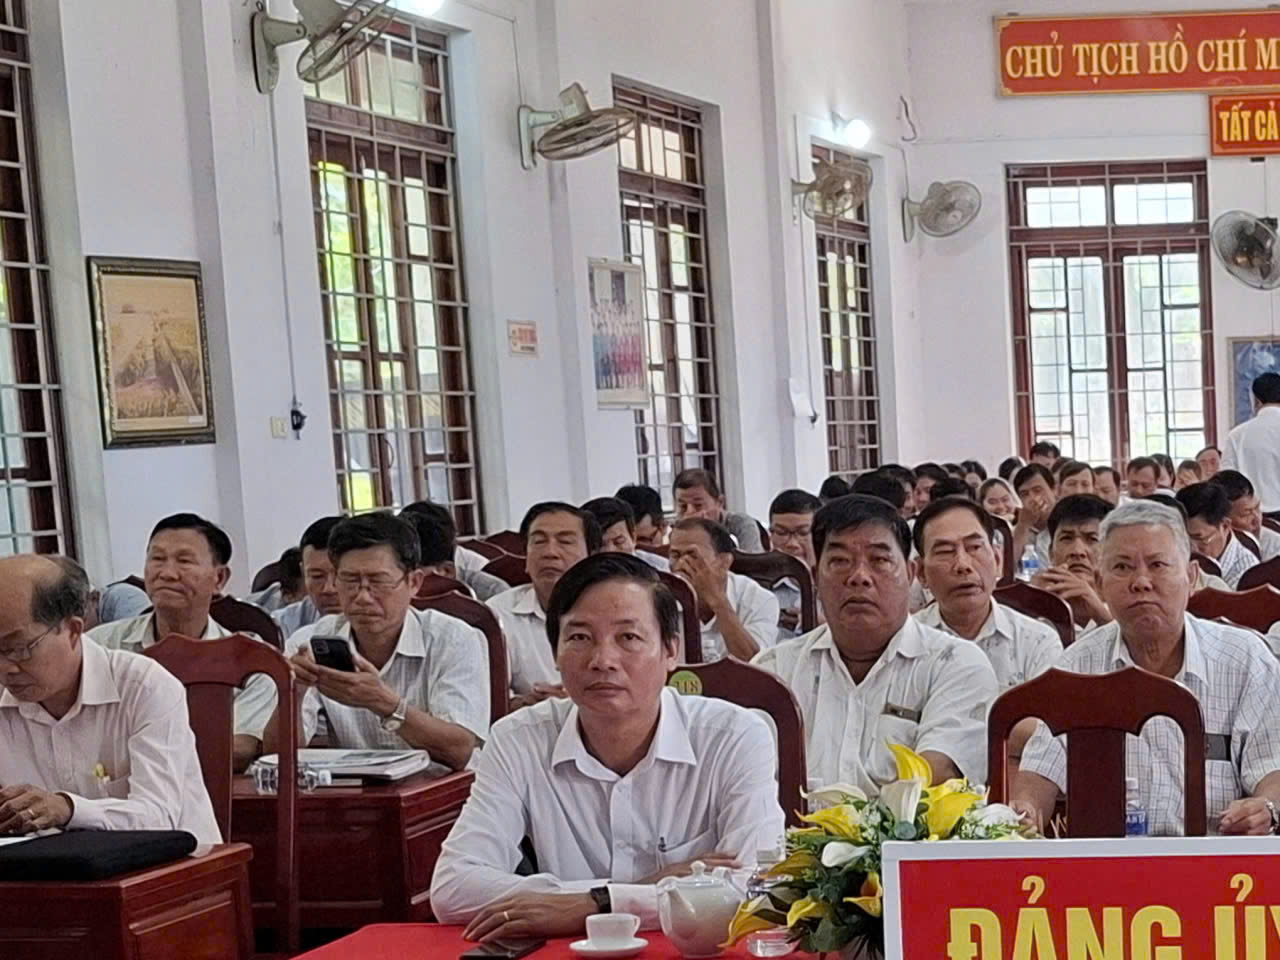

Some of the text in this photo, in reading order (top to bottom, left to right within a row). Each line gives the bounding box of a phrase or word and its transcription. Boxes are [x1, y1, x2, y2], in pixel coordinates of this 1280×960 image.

[1005, 30, 1064, 78] CHỦ
[1072, 42, 1140, 84] TỊCH
[1147, 23, 1188, 74] HỒ
[1197, 28, 1248, 72] CHÍ
[1219, 101, 1251, 142] TẤT
[1254, 100, 1278, 141] CẢ
